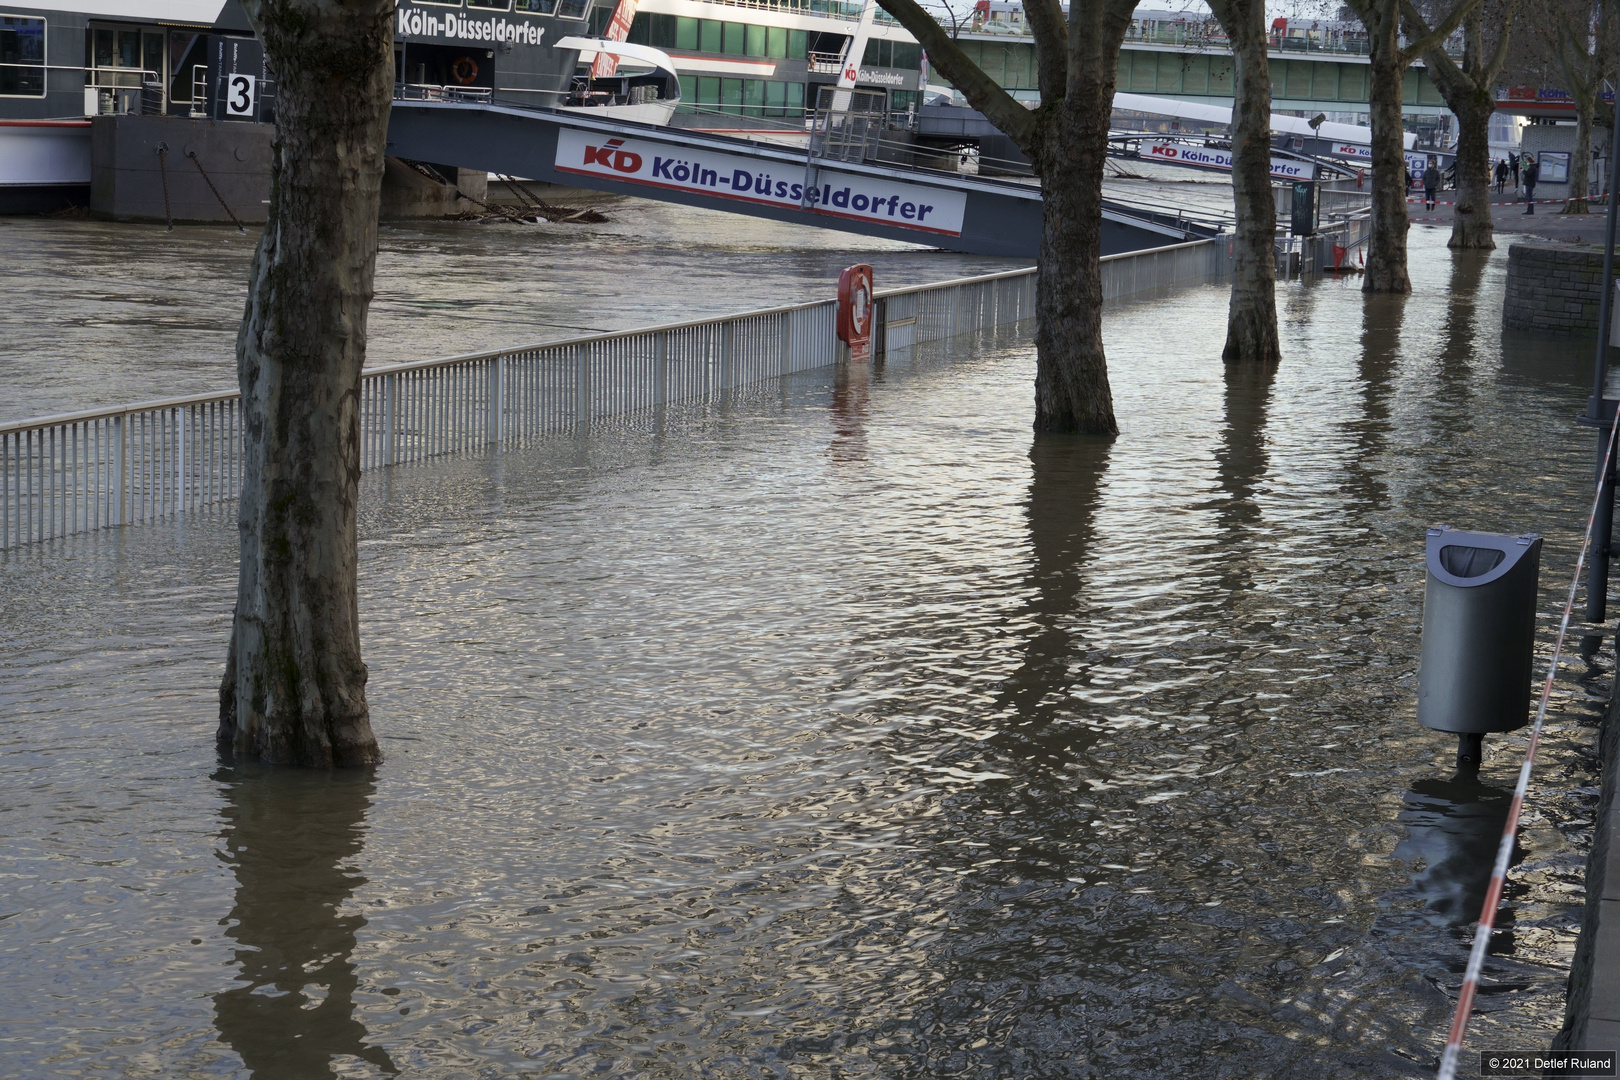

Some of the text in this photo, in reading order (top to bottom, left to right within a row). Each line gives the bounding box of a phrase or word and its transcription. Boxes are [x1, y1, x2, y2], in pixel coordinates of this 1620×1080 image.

[398, 8, 545, 45] Köln-Düsseldorfer
[845, 63, 857, 82] KD
[856, 70, 904, 85] Köln-Düsseldorfer
[230, 76, 251, 113] 3
[1152, 143, 1178, 157] KD
[1340, 144, 1357, 154] KD
[584, 139, 933, 221] KD Köln-Düsseldorfer
